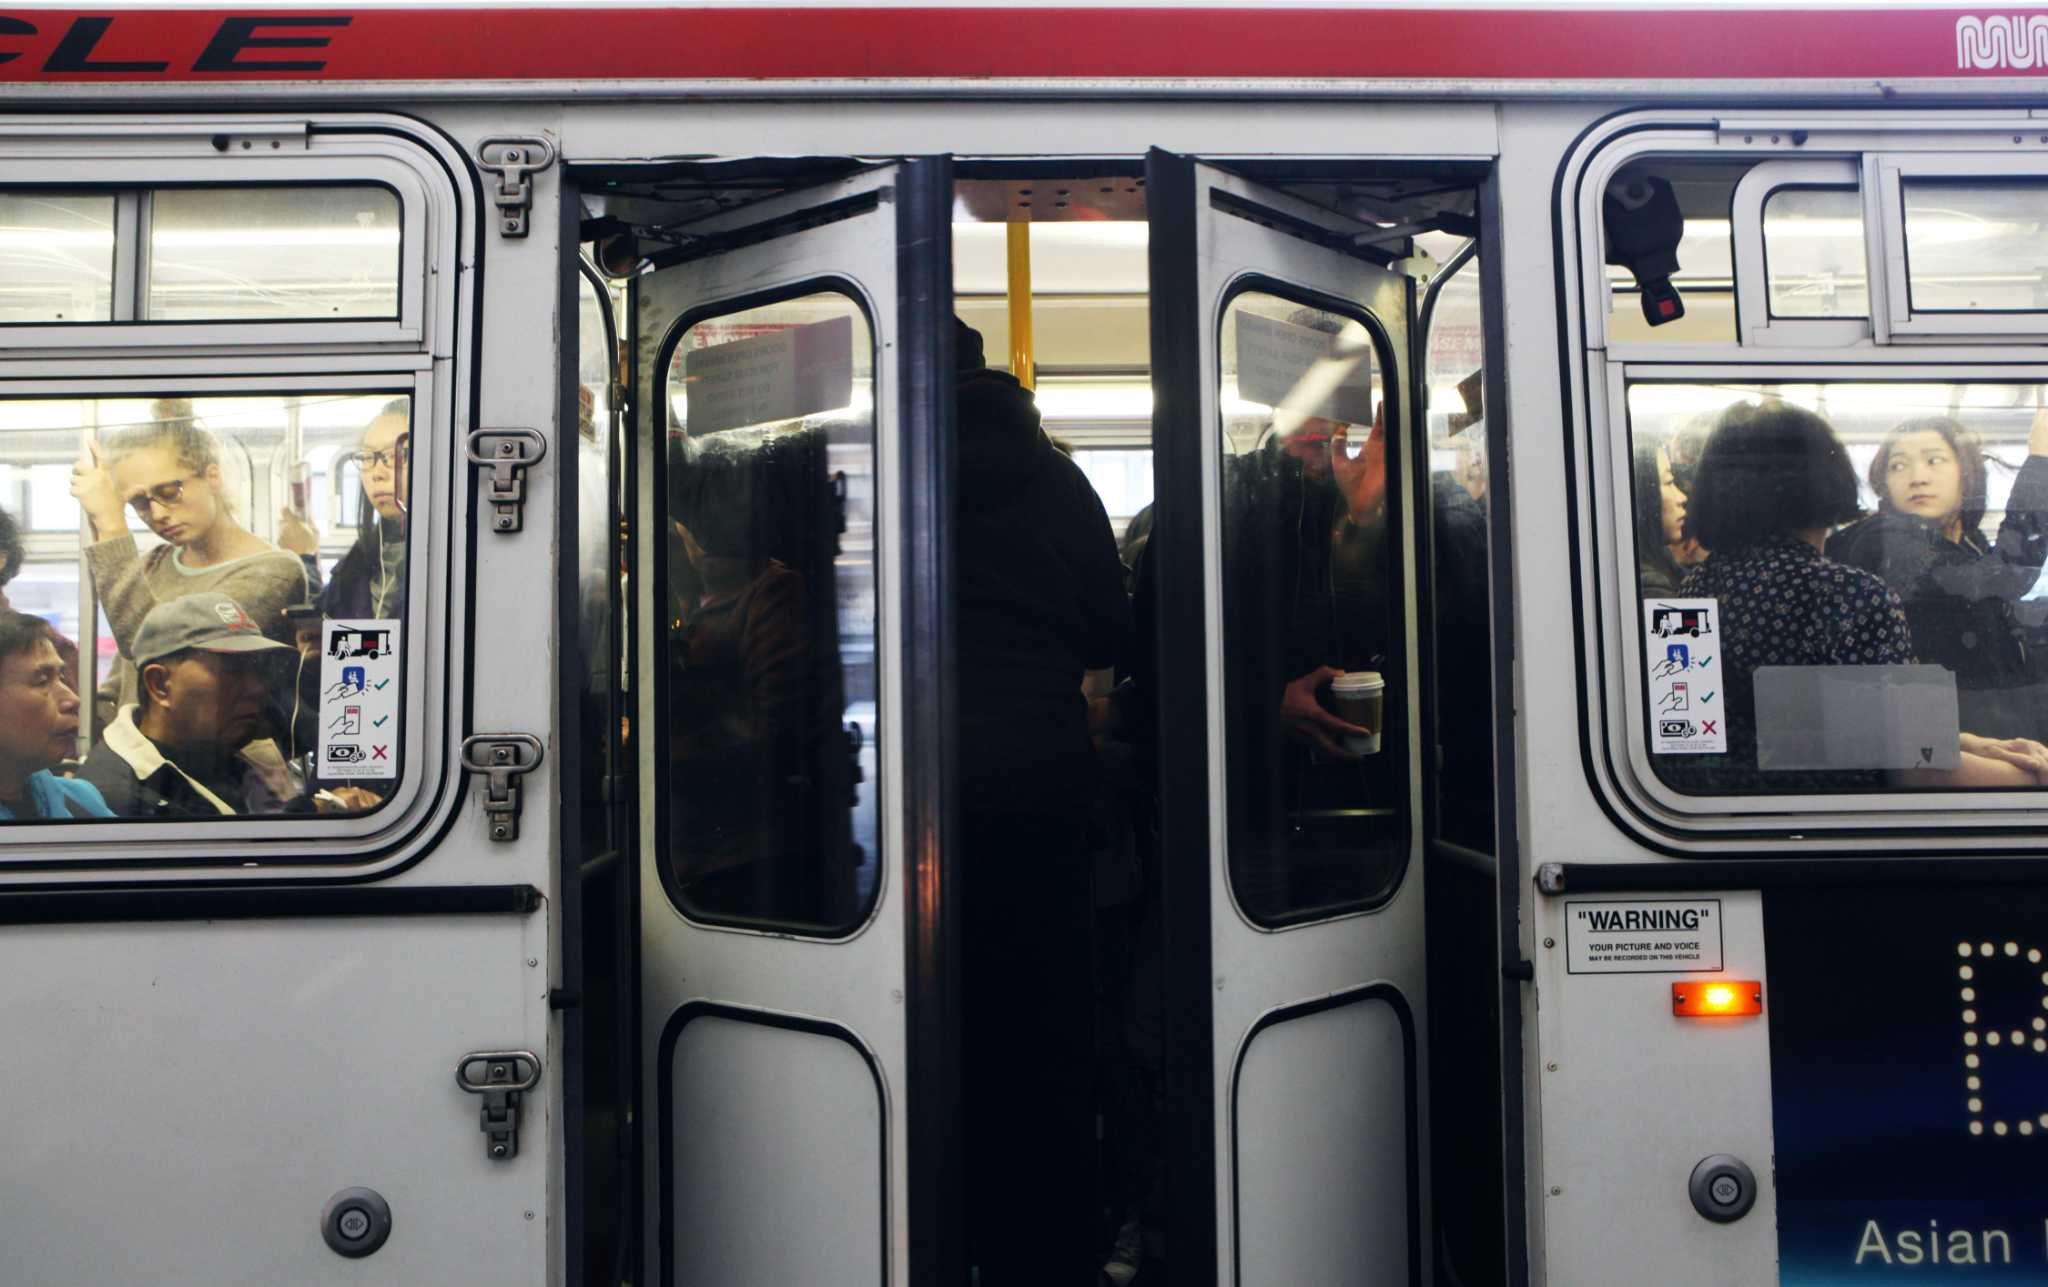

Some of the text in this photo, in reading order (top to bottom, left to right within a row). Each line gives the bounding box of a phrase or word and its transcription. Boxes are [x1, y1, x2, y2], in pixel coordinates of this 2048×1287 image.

[1578, 909, 1709, 931] "WARNING"
[1589, 942, 1700, 951] YOUR PICTURE AND VOICE
[1854, 1219, 2012, 1265] Asian
